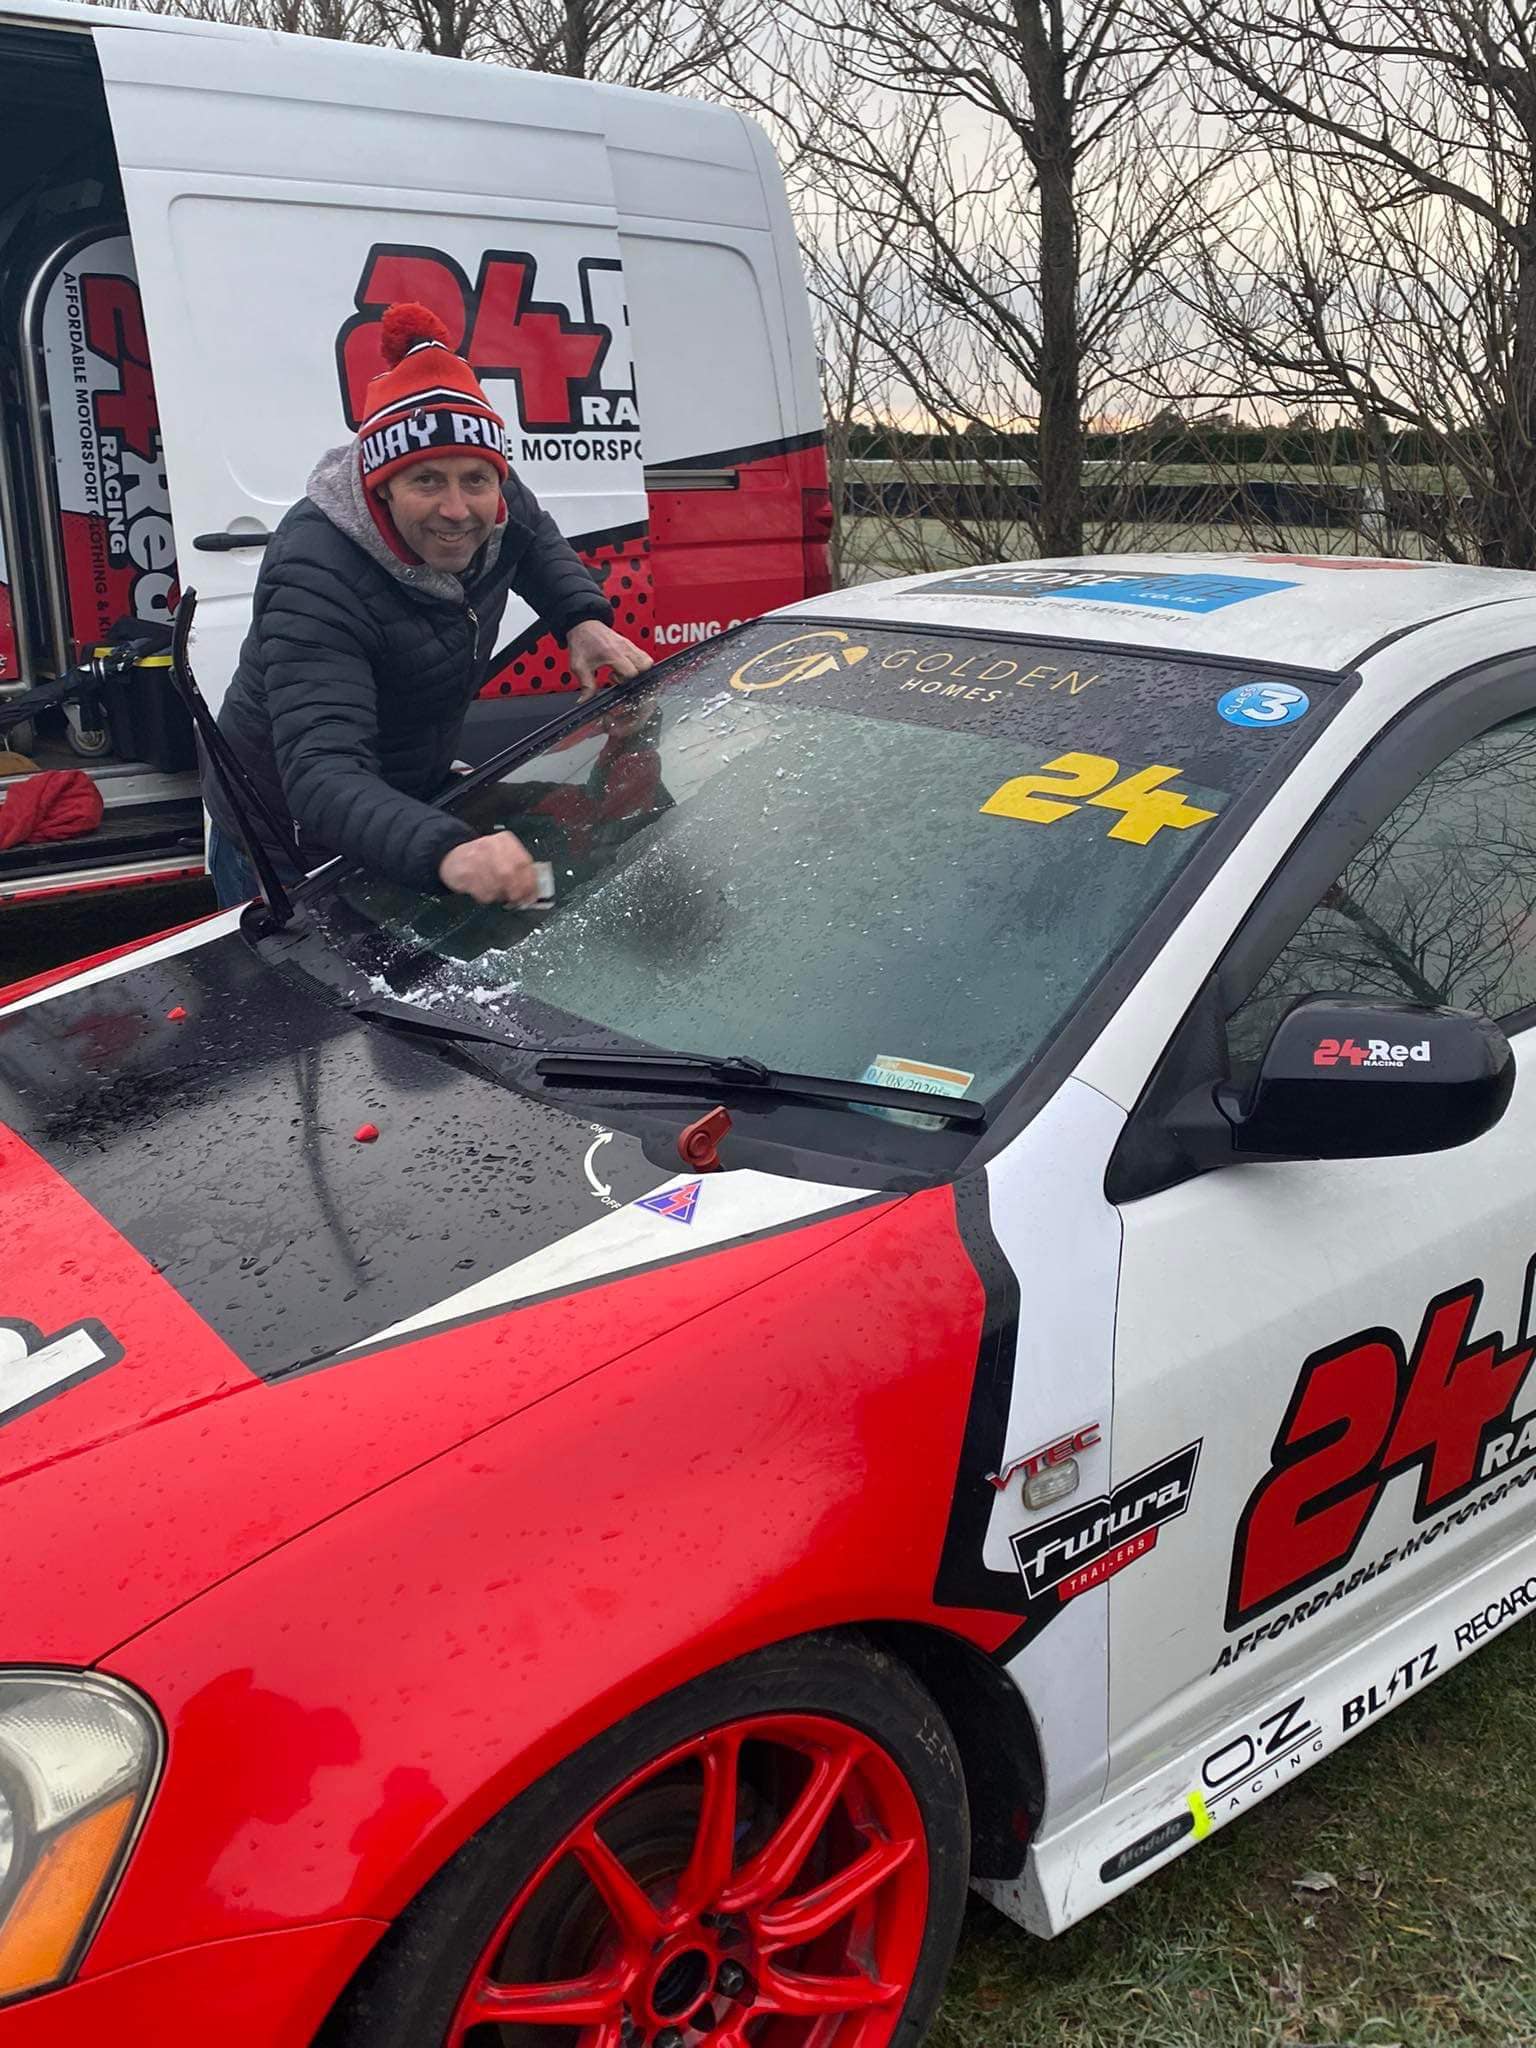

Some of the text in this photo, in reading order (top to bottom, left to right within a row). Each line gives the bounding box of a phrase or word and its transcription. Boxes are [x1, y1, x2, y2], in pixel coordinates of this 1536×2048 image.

[63, 272, 87, 384] AFFORDABLE
[75, 389, 99, 505] MOTORSPORT
[100, 435, 127, 555] RACING
[881, 649, 1100, 695] GOLDEN
[900, 678, 1003, 703] HOMES
[1224, 686, 1257, 715] CLASS
[1241, 688, 1304, 721] 3
[978, 751, 1218, 845] 24
[590, 1123, 606, 1134] ON
[600, 1196, 622, 1209] OFF
[984, 1420, 1102, 1491] VTEC
[1021, 1480, 1190, 1578] Futura
[1210, 1546, 1398, 1676] AFFORDABLE
[1206, 1740, 1324, 1821] RACING
[1118, 1822, 1181, 1869] Modulo
